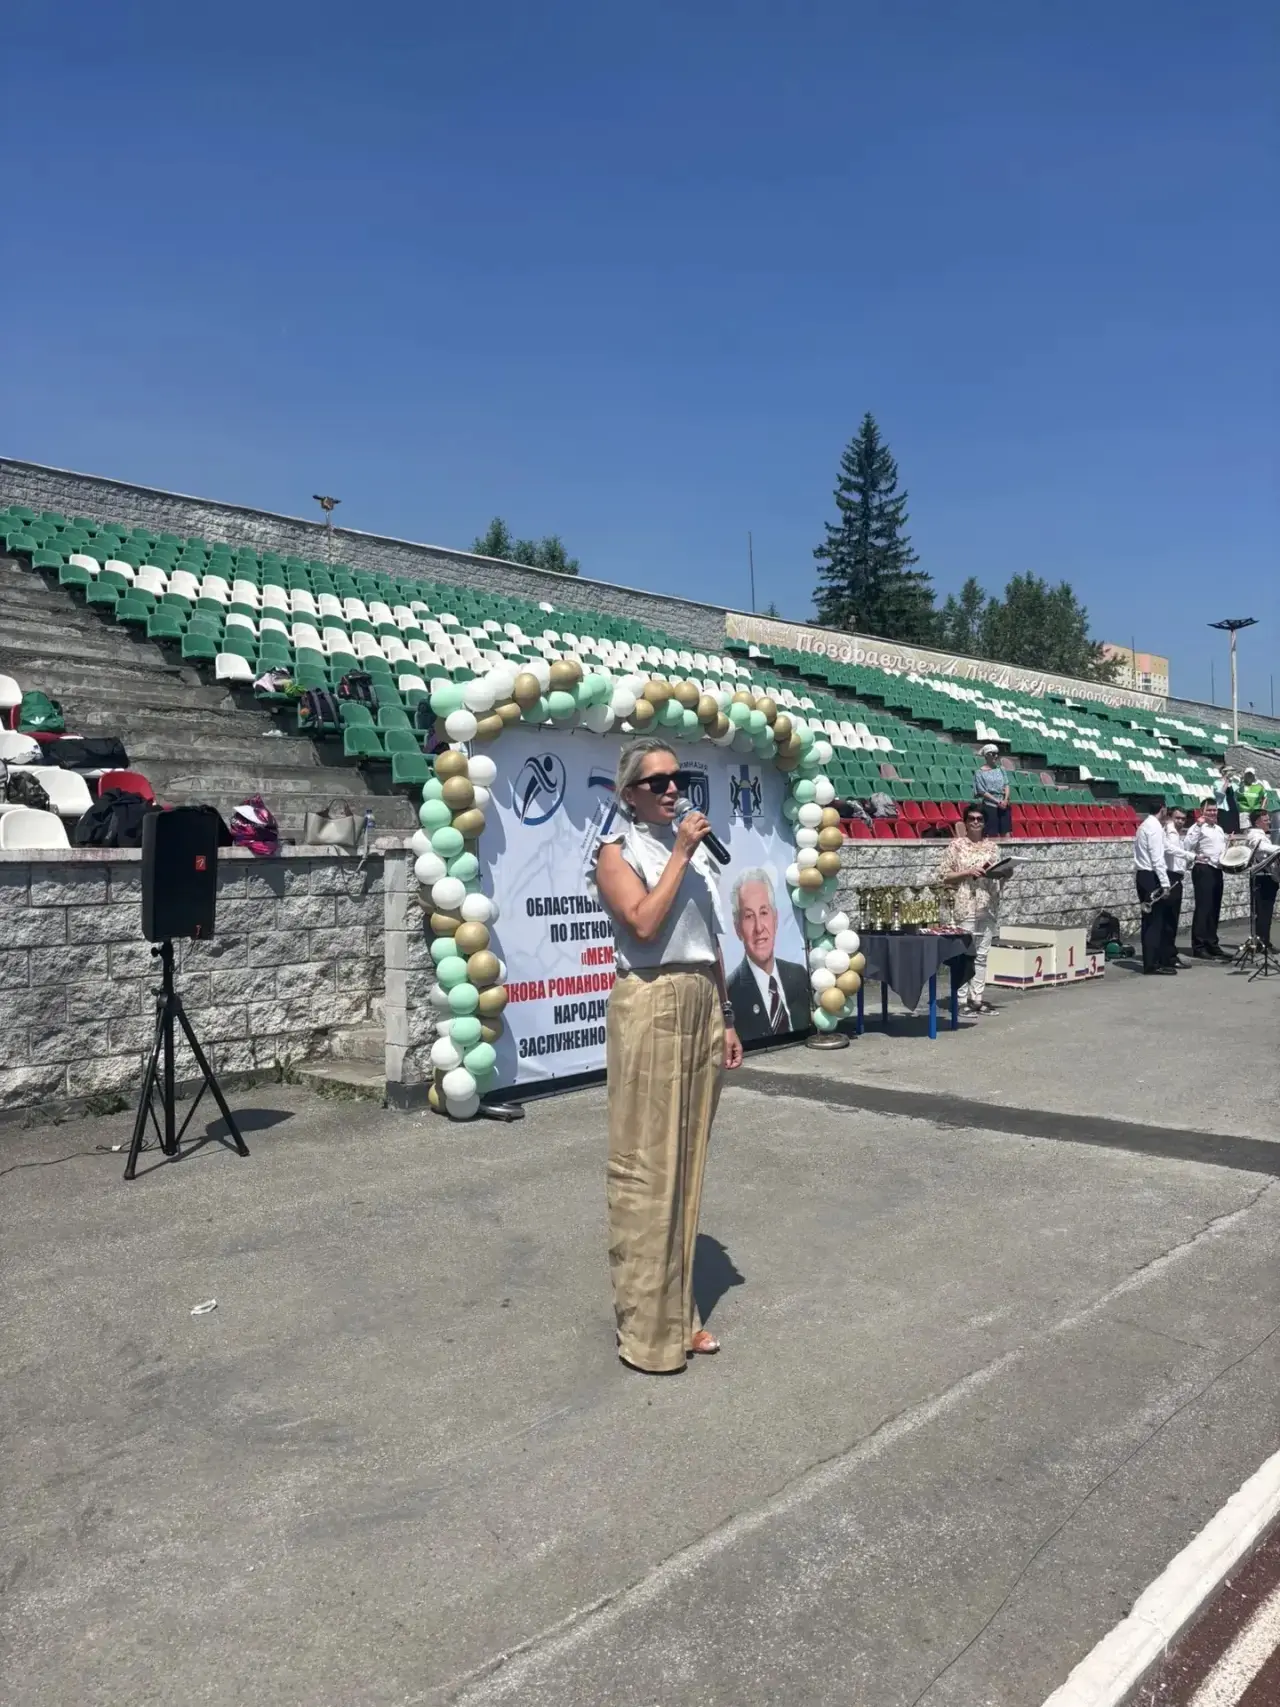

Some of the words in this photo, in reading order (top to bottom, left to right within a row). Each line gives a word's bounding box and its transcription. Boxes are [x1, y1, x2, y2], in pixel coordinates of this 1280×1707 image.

[795, 632, 941, 673] Поздравляем
[550, 923, 568, 943] ПО
[1034, 955, 1043, 978] 2
[1068, 945, 1074, 967] 1
[1090, 955, 1097, 975] 3
[554, 998, 608, 1025] НАРОДН
[519, 1025, 606, 1058] ЗАСЛУЖЕННО
